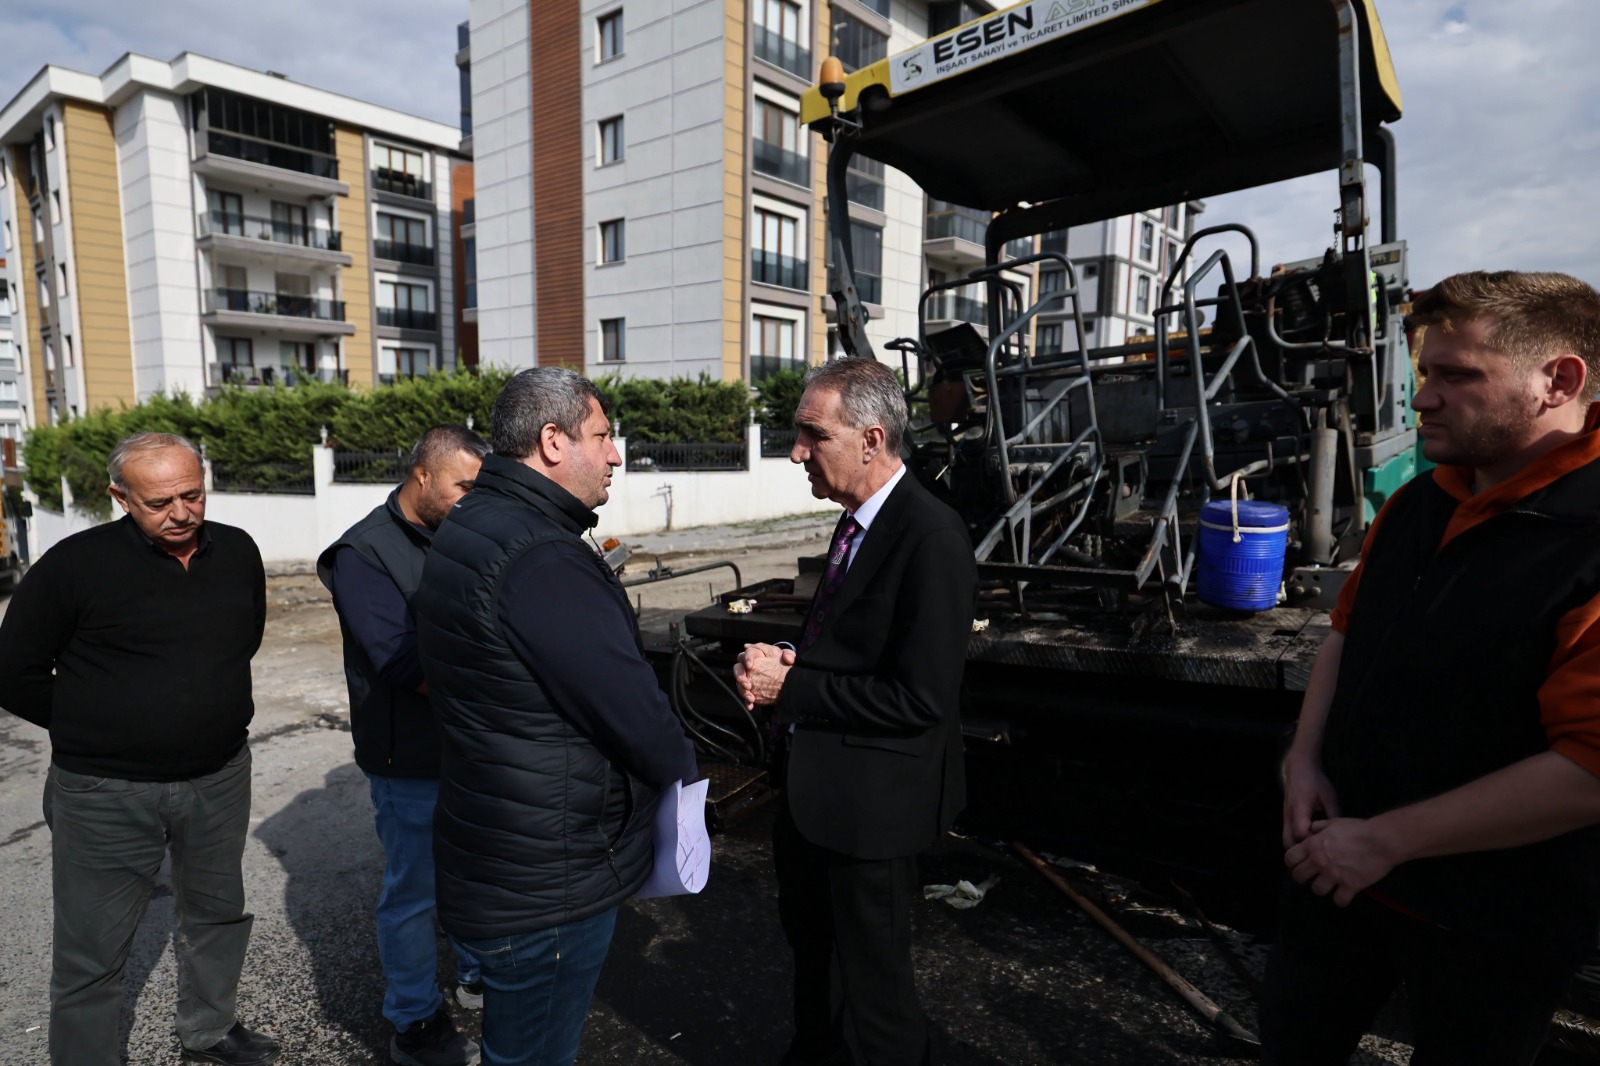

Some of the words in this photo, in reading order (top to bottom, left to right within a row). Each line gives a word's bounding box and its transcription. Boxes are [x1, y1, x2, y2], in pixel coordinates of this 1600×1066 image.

[933, 5, 1033, 64] ESEN
[936, 57, 968, 75] İNŞAAT
[971, 41, 1006, 62] SANAYİ
[1007, 40, 1018, 49] ve
[1021, 21, 1064, 44] TİCARET
[1066, 5, 1109, 27] LİMİTED
